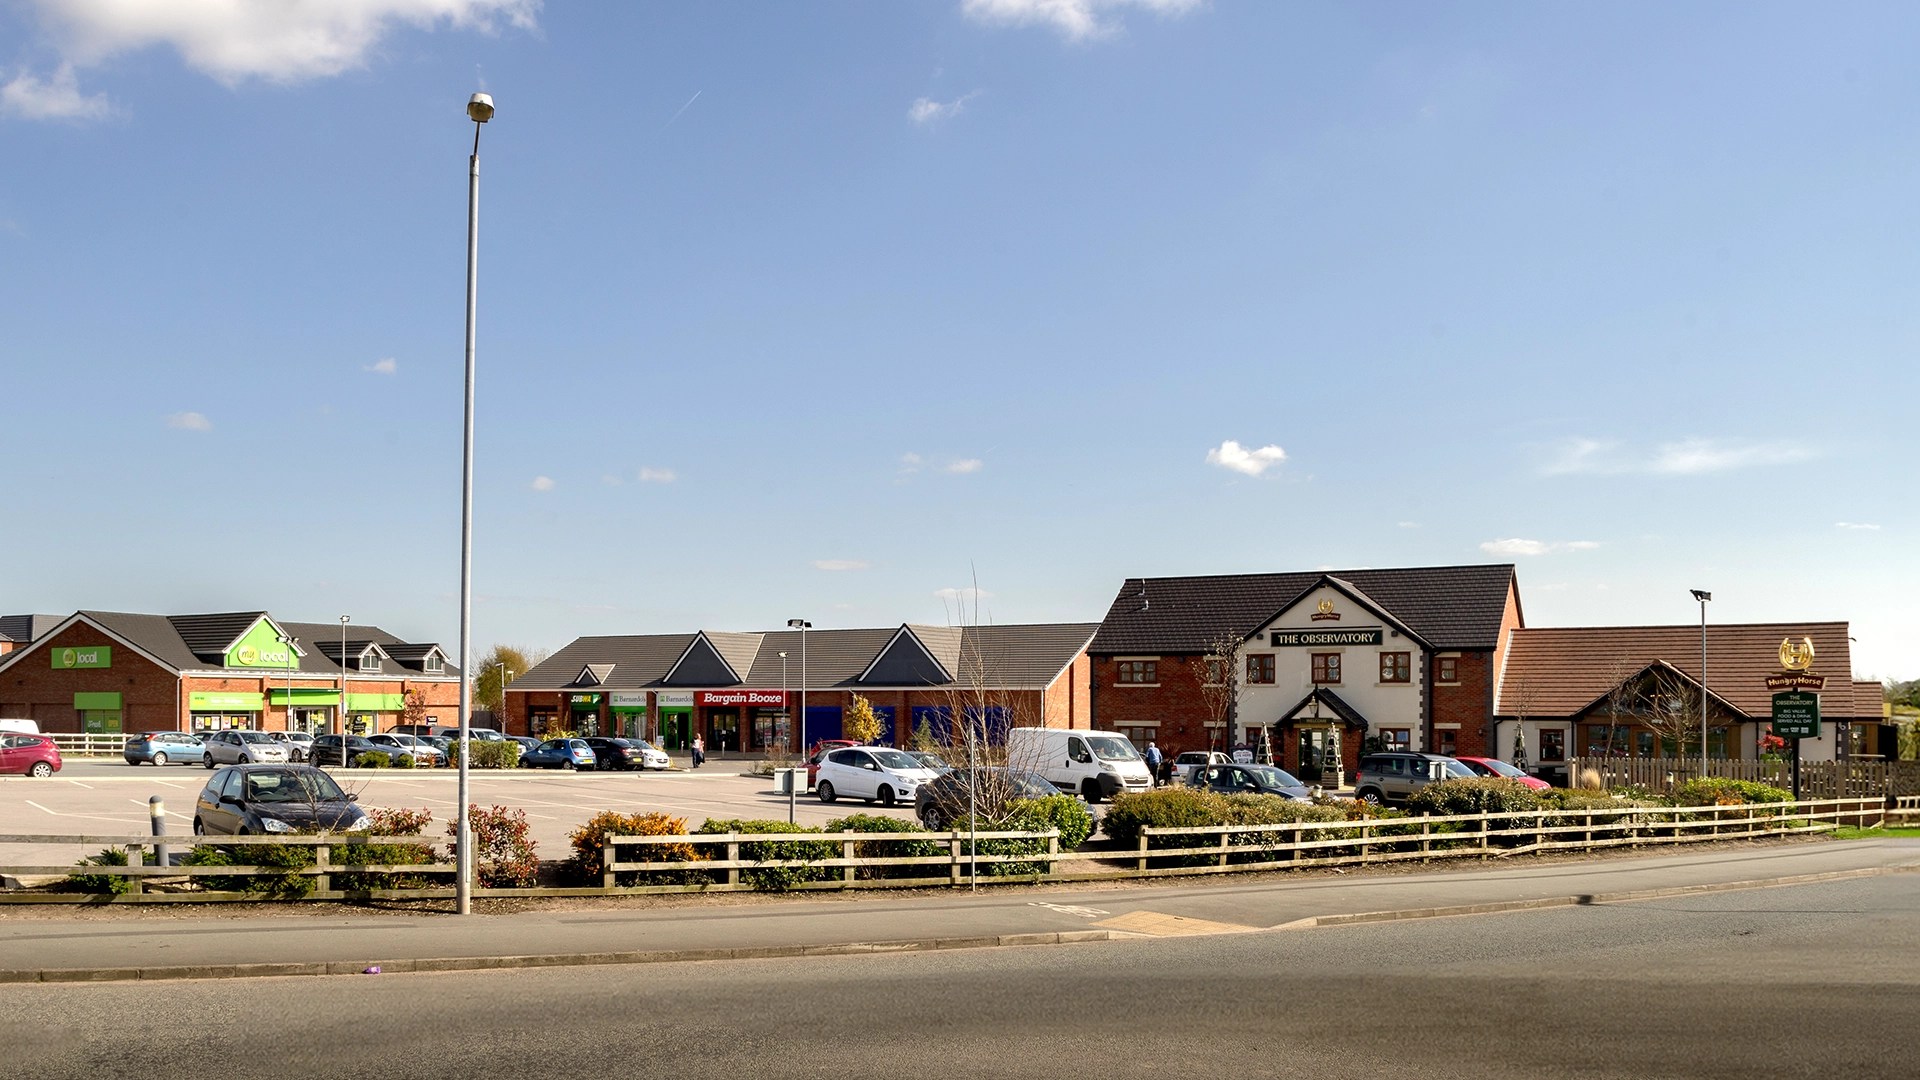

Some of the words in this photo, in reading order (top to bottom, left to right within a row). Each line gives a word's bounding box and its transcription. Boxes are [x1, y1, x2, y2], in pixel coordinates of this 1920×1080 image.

[1278, 634, 1299, 644] THE
[1300, 633, 1375, 644] OBSERVATORY
[77, 652, 97, 663] local
[241, 649, 256, 662] my
[260, 650, 289, 662] local
[704, 692, 747, 705] Bargain
[748, 693, 782, 703] Booze
